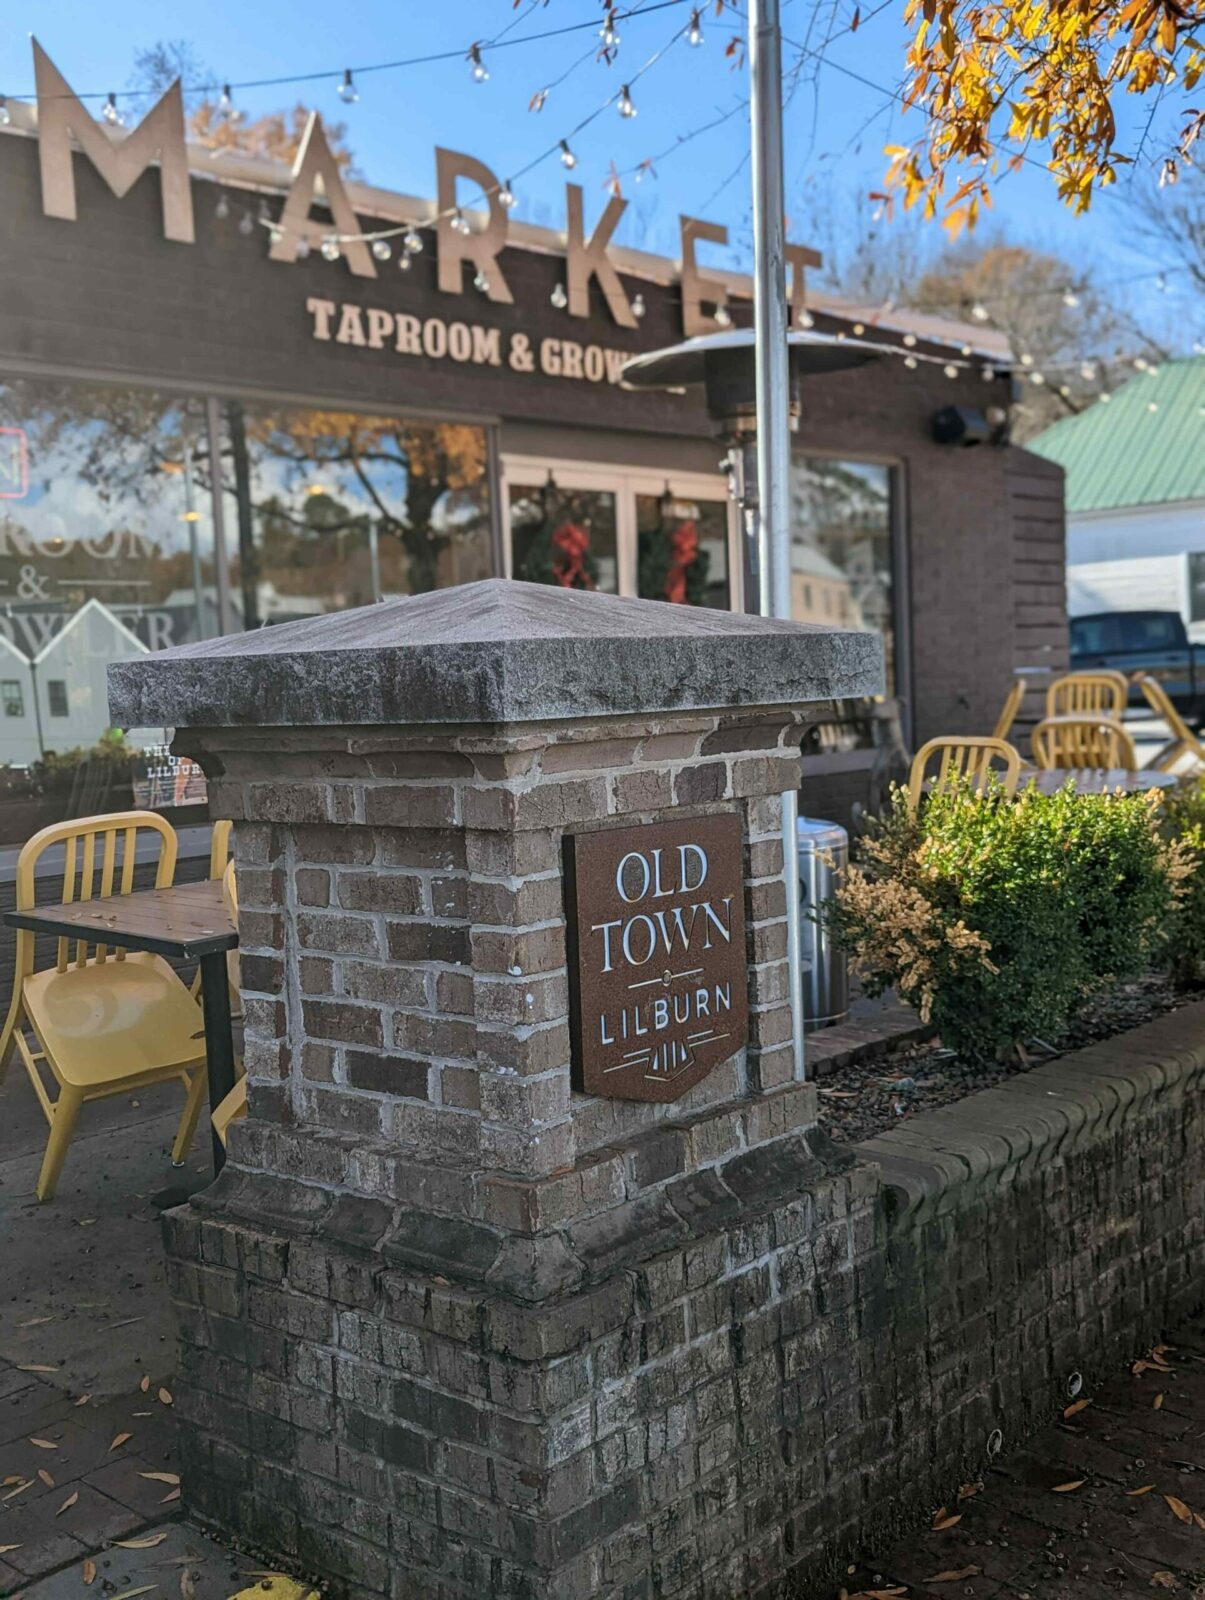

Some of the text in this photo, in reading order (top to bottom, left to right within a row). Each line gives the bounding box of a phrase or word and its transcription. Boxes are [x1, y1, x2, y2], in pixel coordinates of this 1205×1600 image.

[30, 35, 822, 338] MARKET
[306, 297, 502, 367] TAPROOM
[509, 332, 536, 373] &
[16, 564, 50, 600] &
[147, 763, 204, 778] LILBUR
[616, 843, 709, 903] OLD
[591, 897, 735, 973] TOWN
[601, 982, 731, 1045] LILBURN
